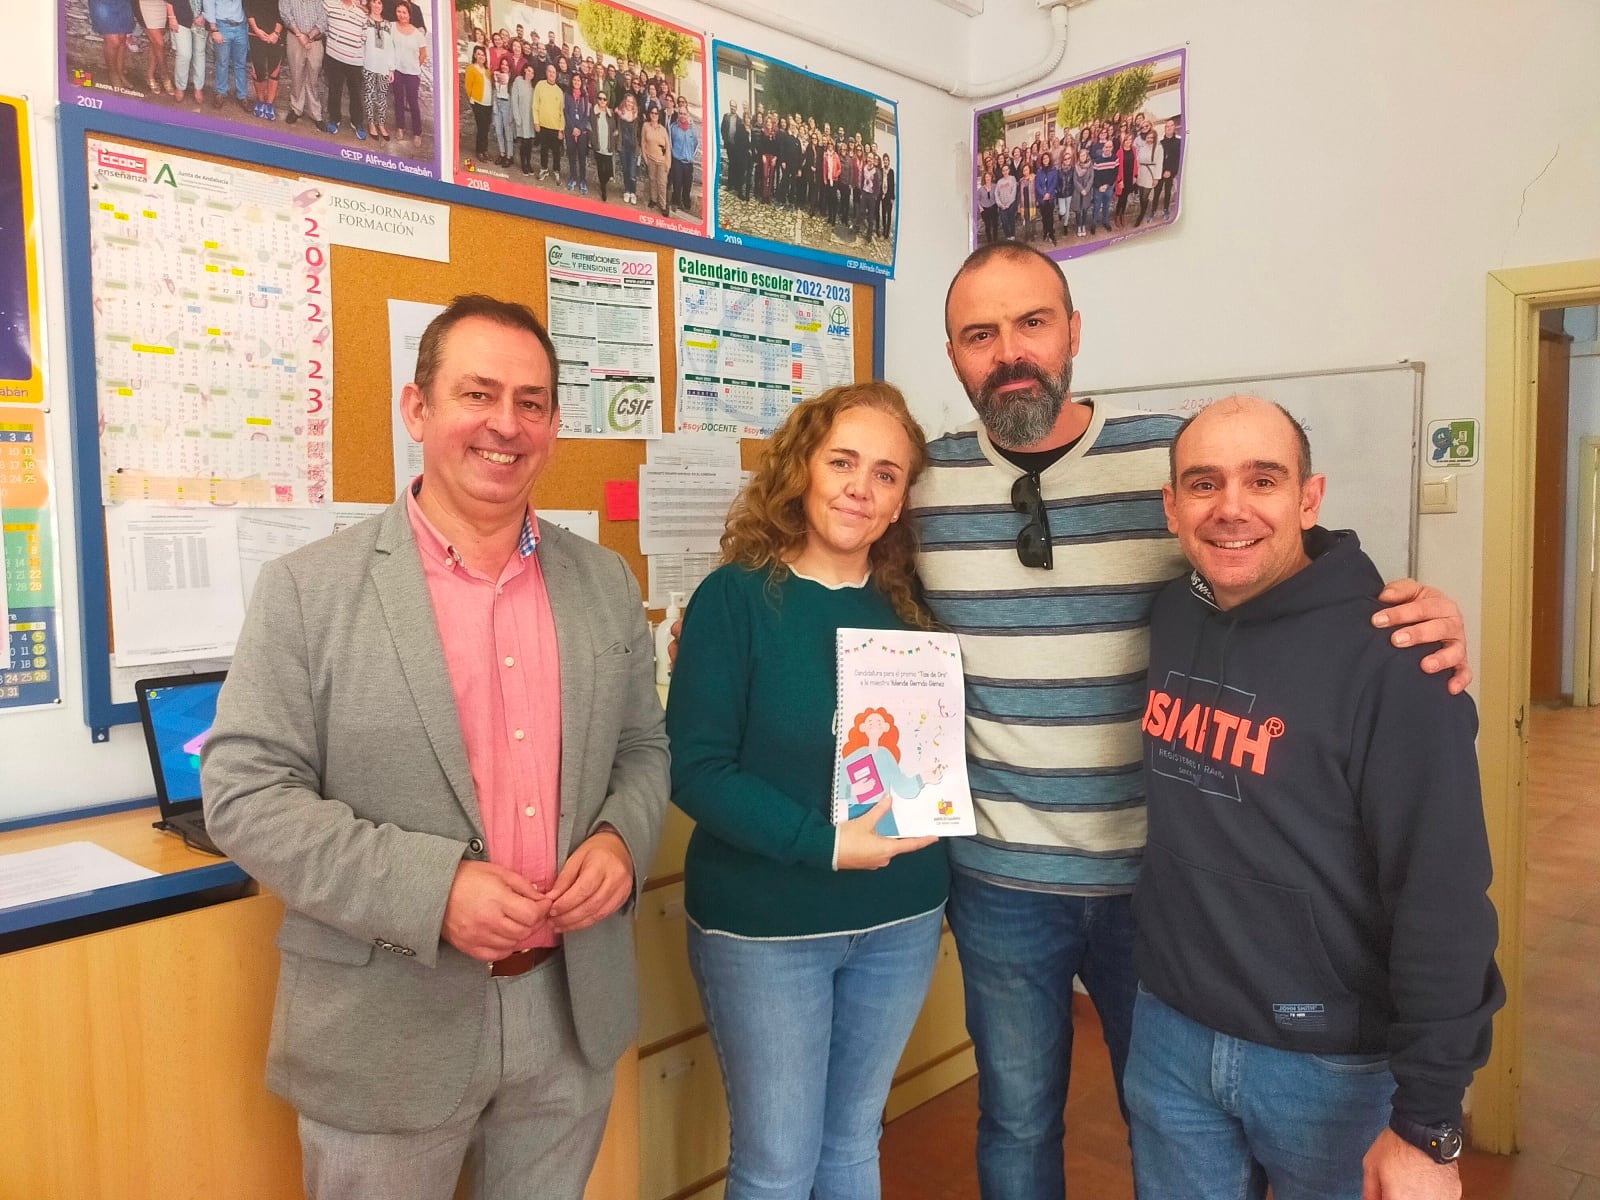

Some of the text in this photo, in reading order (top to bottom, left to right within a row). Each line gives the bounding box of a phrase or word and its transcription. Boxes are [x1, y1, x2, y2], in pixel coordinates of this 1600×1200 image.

[77, 94, 104, 110] 2017
[341, 148, 363, 162] CEIP
[365, 153, 397, 170] Alfredo
[98, 166, 148, 183] enseñanza
[466, 177, 490, 192] 2018
[338, 213, 414, 237] FORMACIÓN
[655, 217, 678, 232] Alfredo
[723, 233, 743, 246] 2019
[571, 251, 621, 265] RETRIBUCIONES
[578, 262, 618, 274] PENSIONES
[621, 261, 653, 276] 2022
[679, 256, 851, 303] Calendario escolar 2022-2023
[827, 323, 850, 336] ANPE
[617, 397, 654, 415] CSIF
[682, 421, 737, 433] #soyDOCENTE
[9, 432, 32, 442] 3 4
[30, 570, 42, 579] 22
[30, 582, 42, 592] 29
[21, 633, 27, 641] 4
[20, 647, 29, 656] 11
[20, 659, 31, 669] 18
[7, 674, 18, 683] 24
[22, 673, 33, 682] 25
[8, 687, 18, 697] 31
